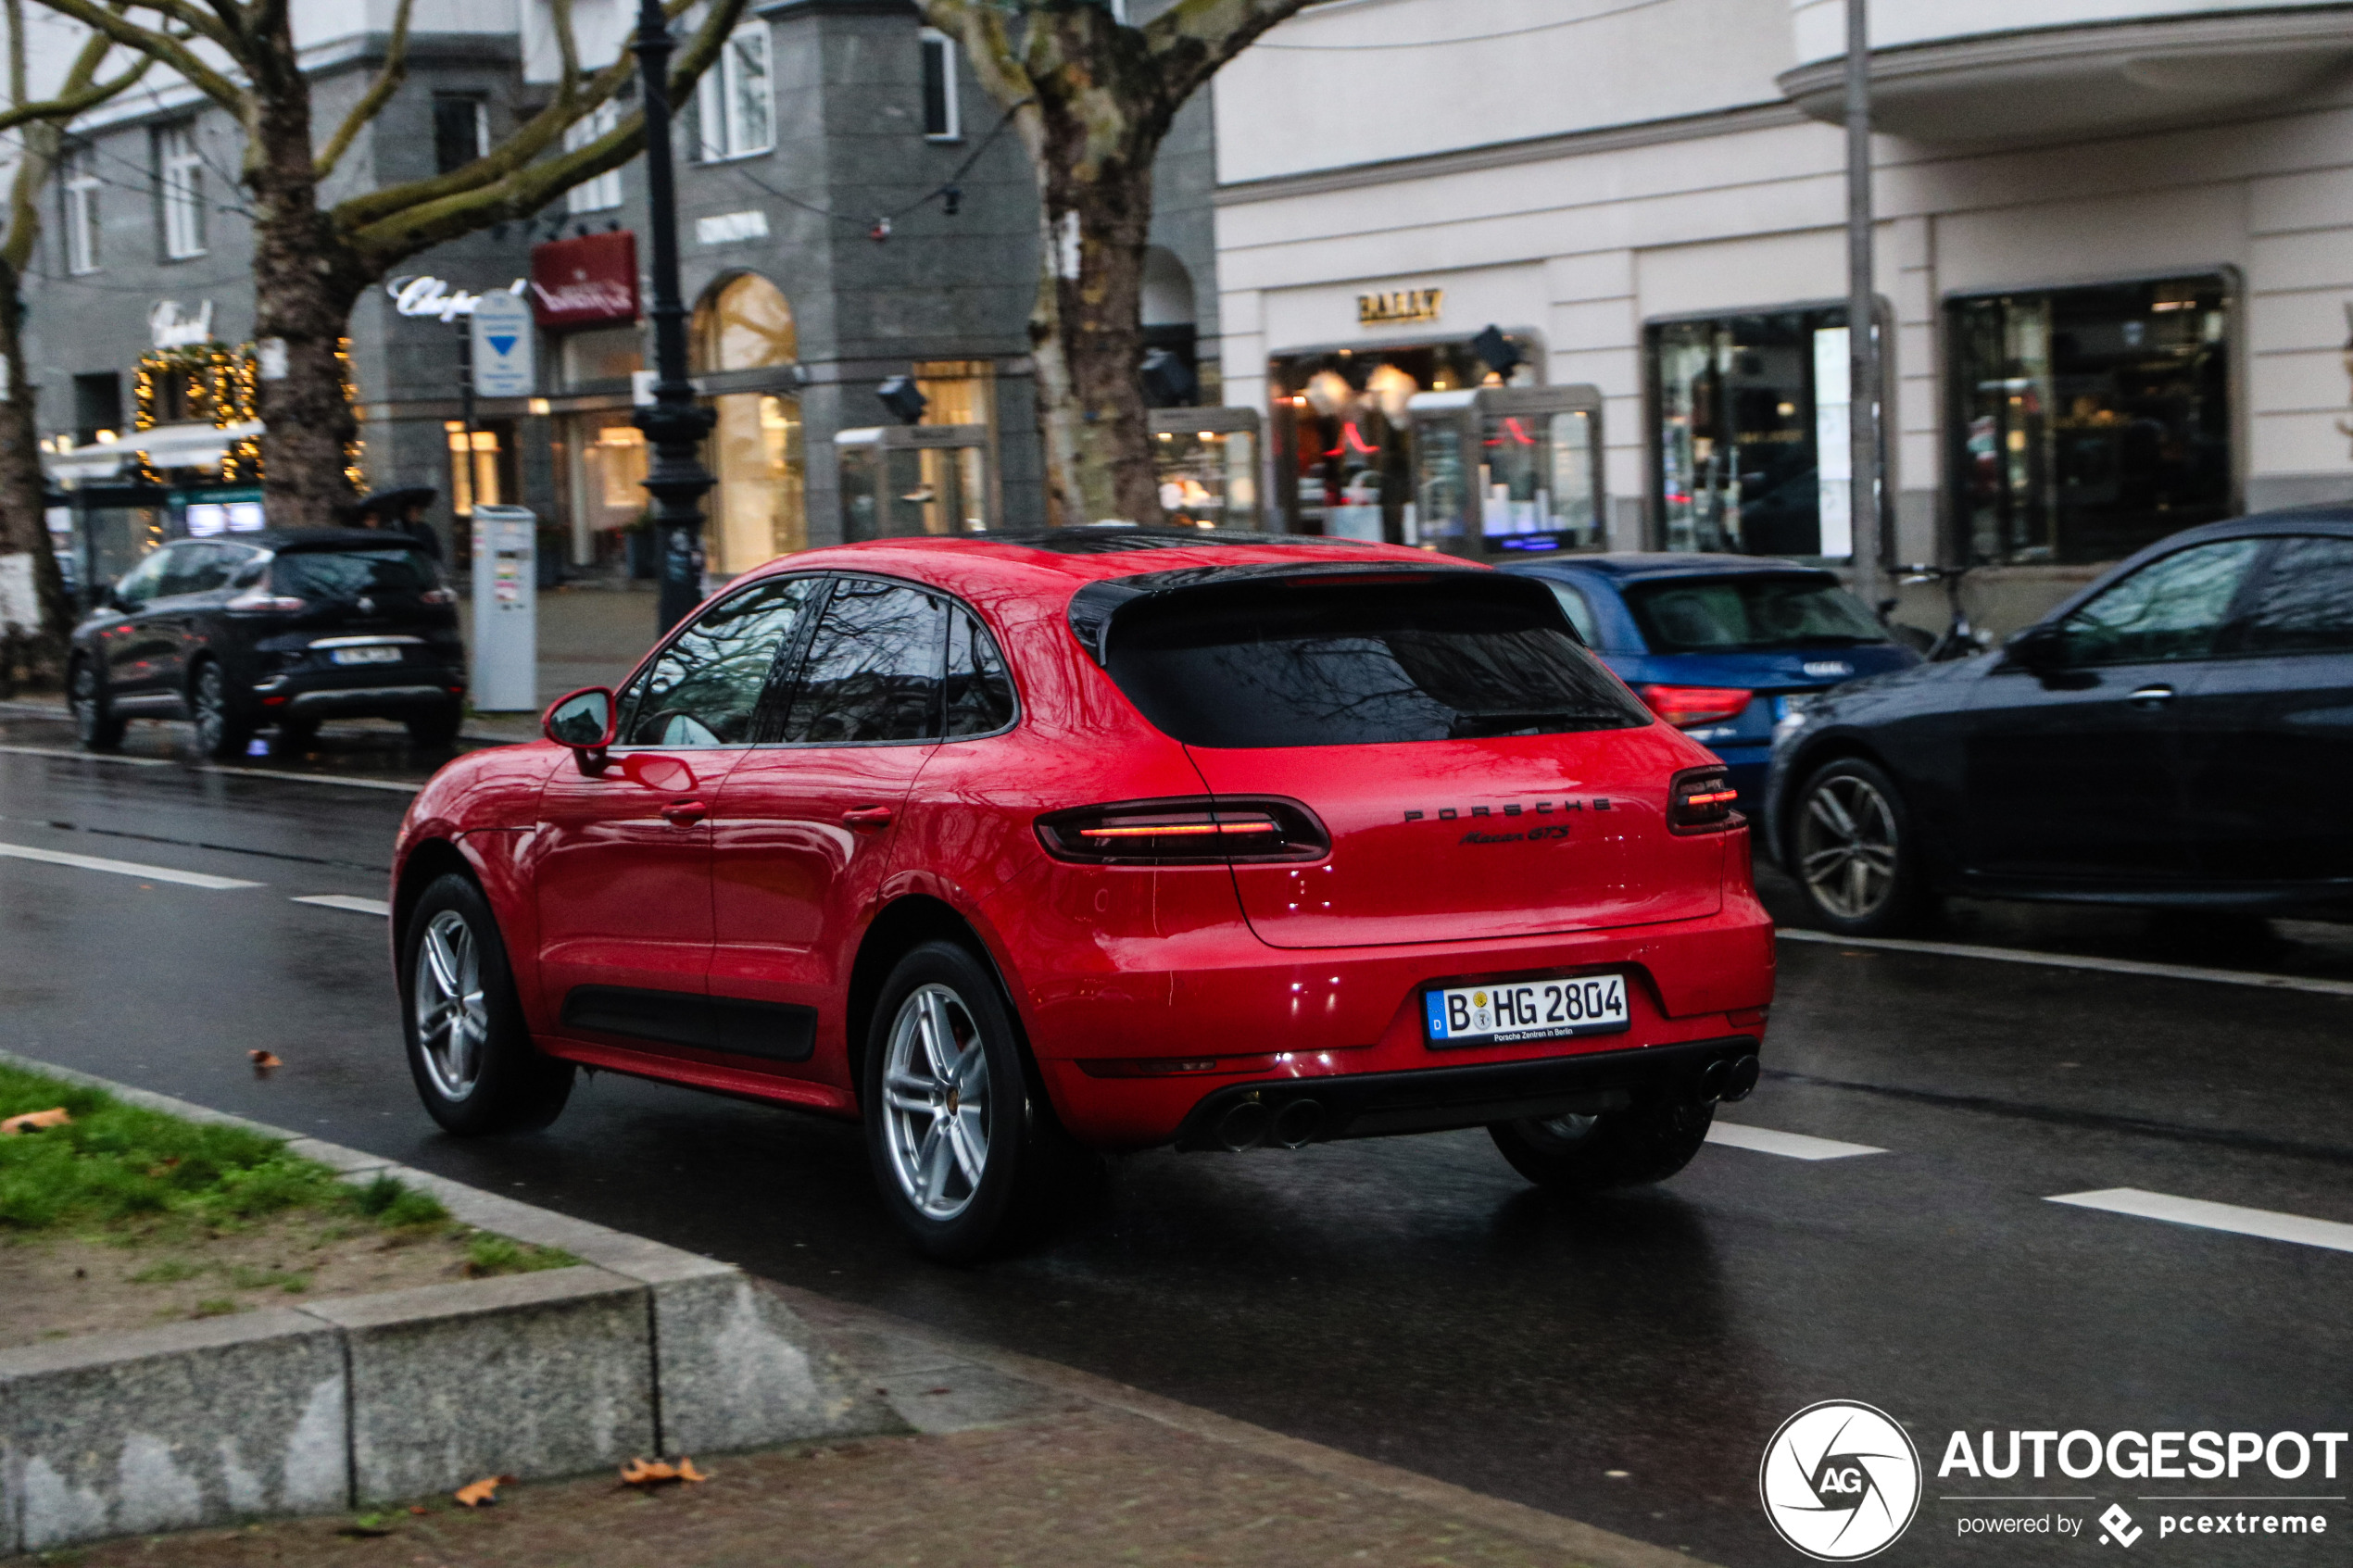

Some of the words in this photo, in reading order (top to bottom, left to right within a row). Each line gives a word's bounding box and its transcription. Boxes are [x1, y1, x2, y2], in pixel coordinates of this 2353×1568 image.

[1404, 798, 1611, 822] PORSCHE
[1459, 831, 1524, 846] Macan
[1528, 824, 1569, 840] GTS
[1433, 1019, 1441, 1031] D
[1447, 993, 1471, 1031] B
[1492, 987, 1538, 1027] HG
[1544, 980, 1622, 1022] 2804
[1493, 1033, 1521, 1042] Porsche
[1554, 1027, 1573, 1035] Berlin
